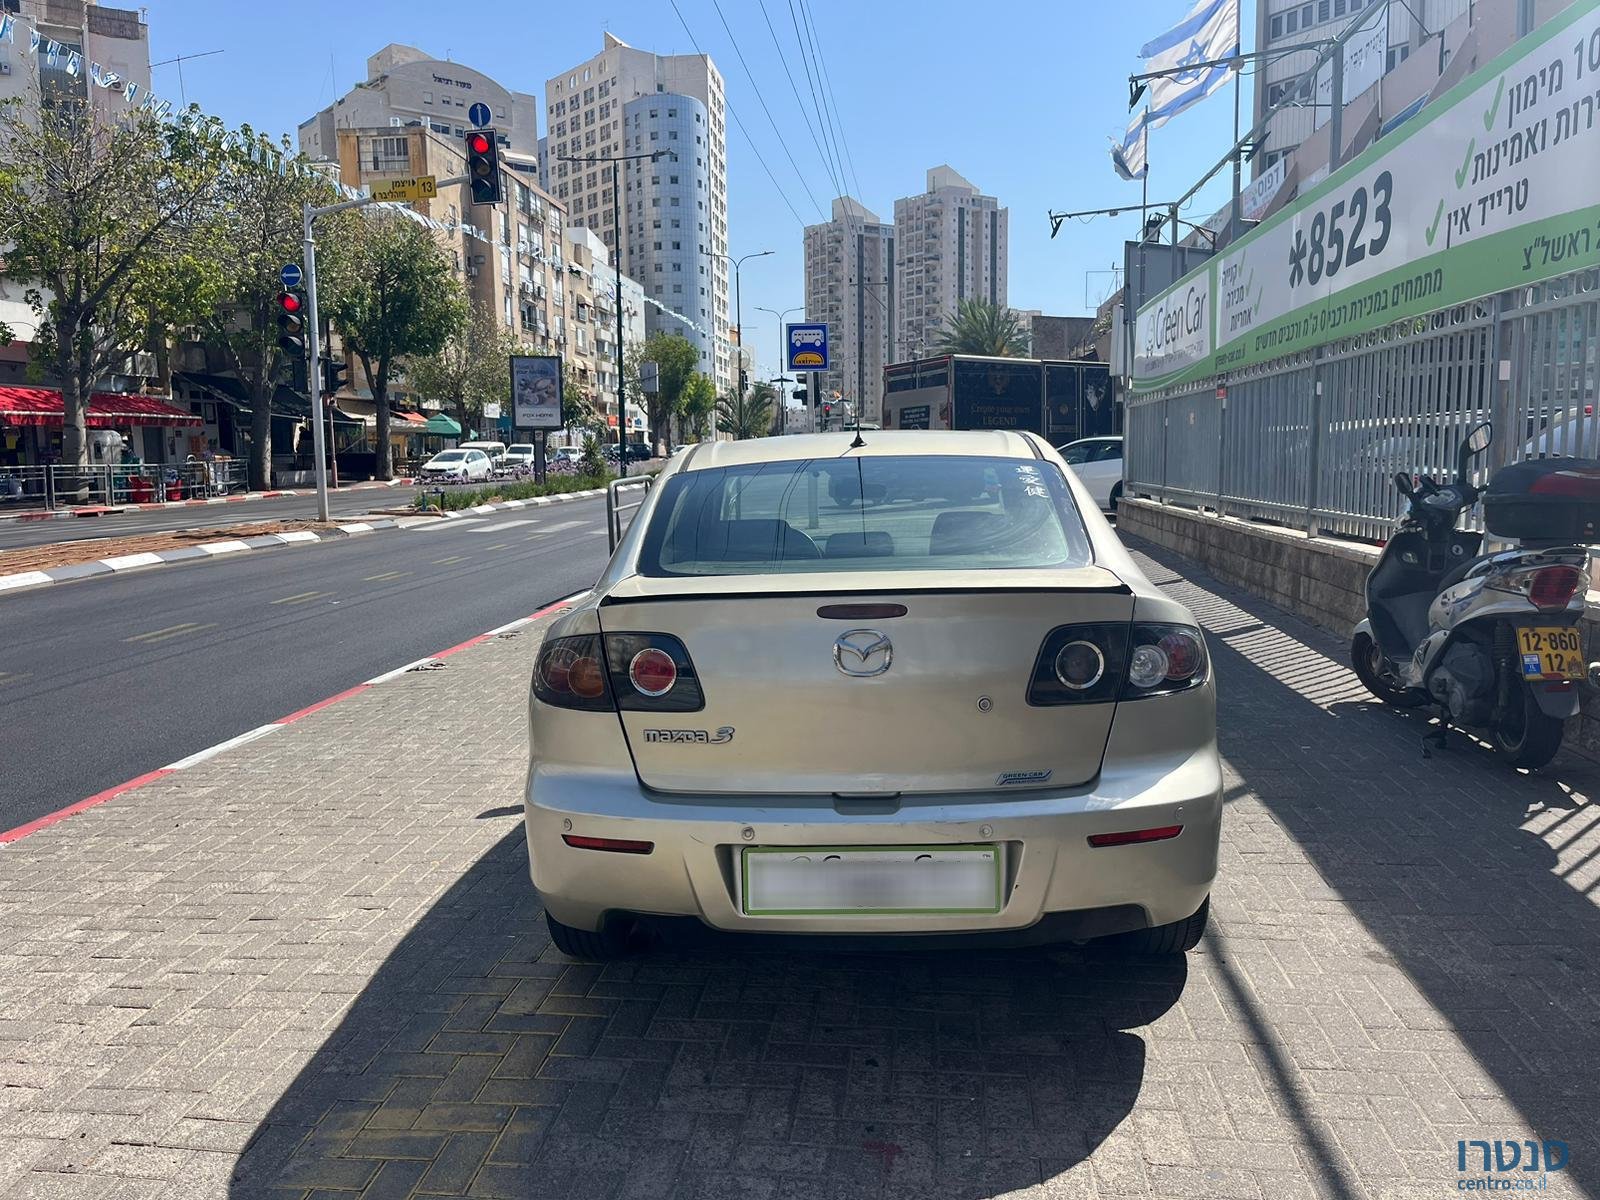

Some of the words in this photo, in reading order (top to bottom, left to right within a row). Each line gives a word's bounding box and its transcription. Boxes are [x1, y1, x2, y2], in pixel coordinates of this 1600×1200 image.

[1508, 58, 1563, 129] מימון
[1472, 118, 1547, 186] ואמינות
[391, 179, 411, 191] ויצמן
[421, 181, 433, 193] 13
[1478, 178, 1529, 226] טרייד
[1446, 203, 1472, 250] אין
[1522, 227, 1591, 271] ראשל"צ
[1391, 268, 1442, 307] מתמחים
[1156, 306, 1184, 350] Green
[1185, 286, 1207, 335] Car
[1328, 305, 1347, 328] רכבי
[1349, 289, 1388, 322] במכירת
[1255, 330, 1277, 352] חדשים
[1279, 321, 1301, 344] ורכבים
[1522, 632, 1578, 652] 12-860
[1545, 653, 1566, 672] 12
